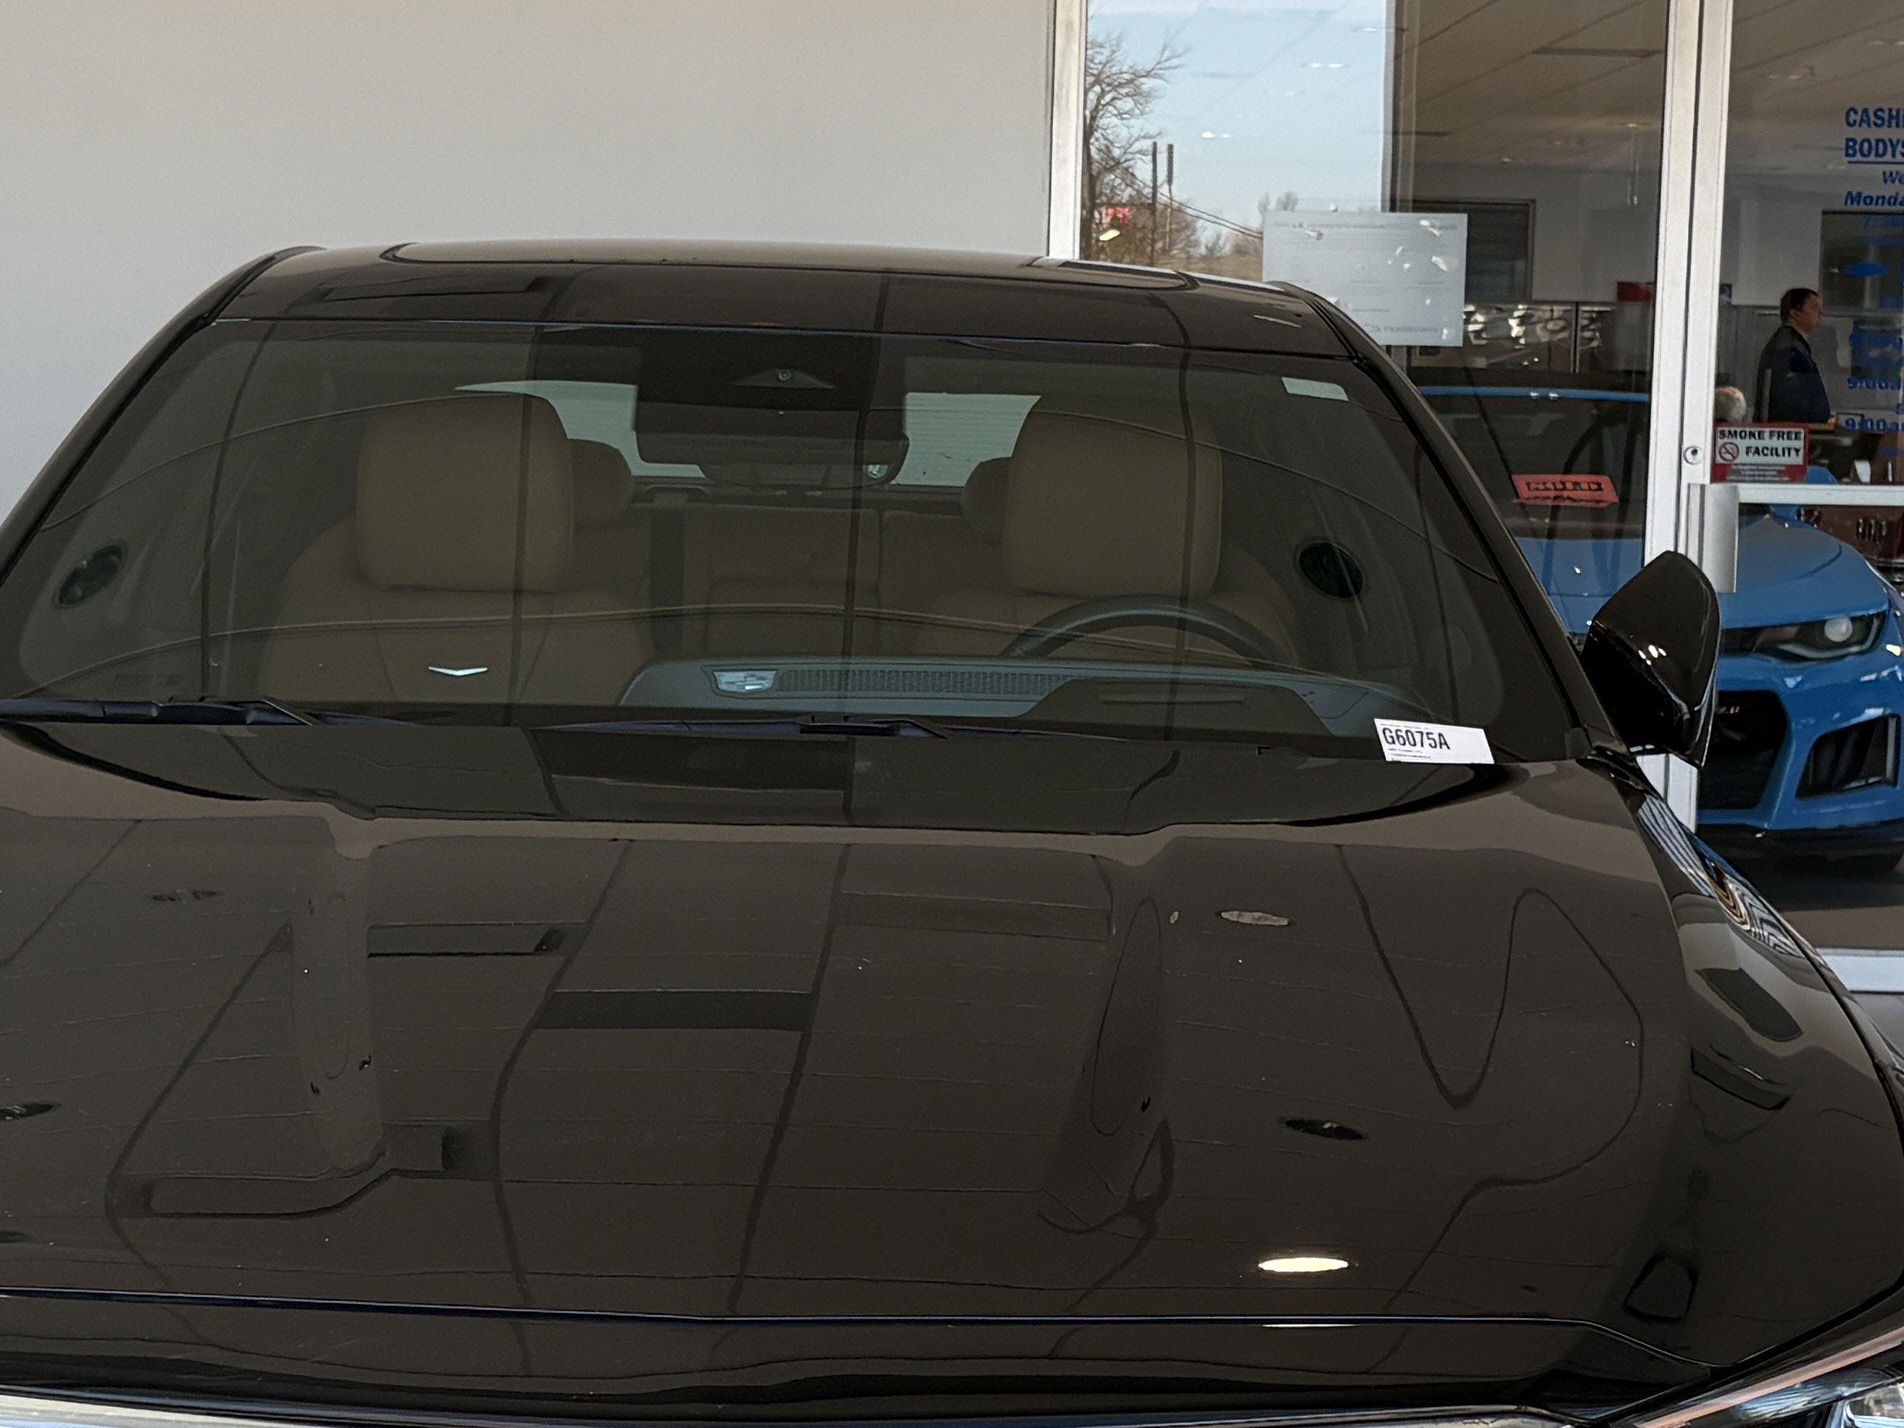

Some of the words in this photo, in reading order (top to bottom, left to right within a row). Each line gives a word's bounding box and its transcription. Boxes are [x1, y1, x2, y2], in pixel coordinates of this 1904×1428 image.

[1718, 429, 1765, 441] SMOKE
[1768, 430, 1802, 441] FREE
[1745, 445, 1802, 458] FACILITY
[1381, 727, 1451, 750] G6075A
